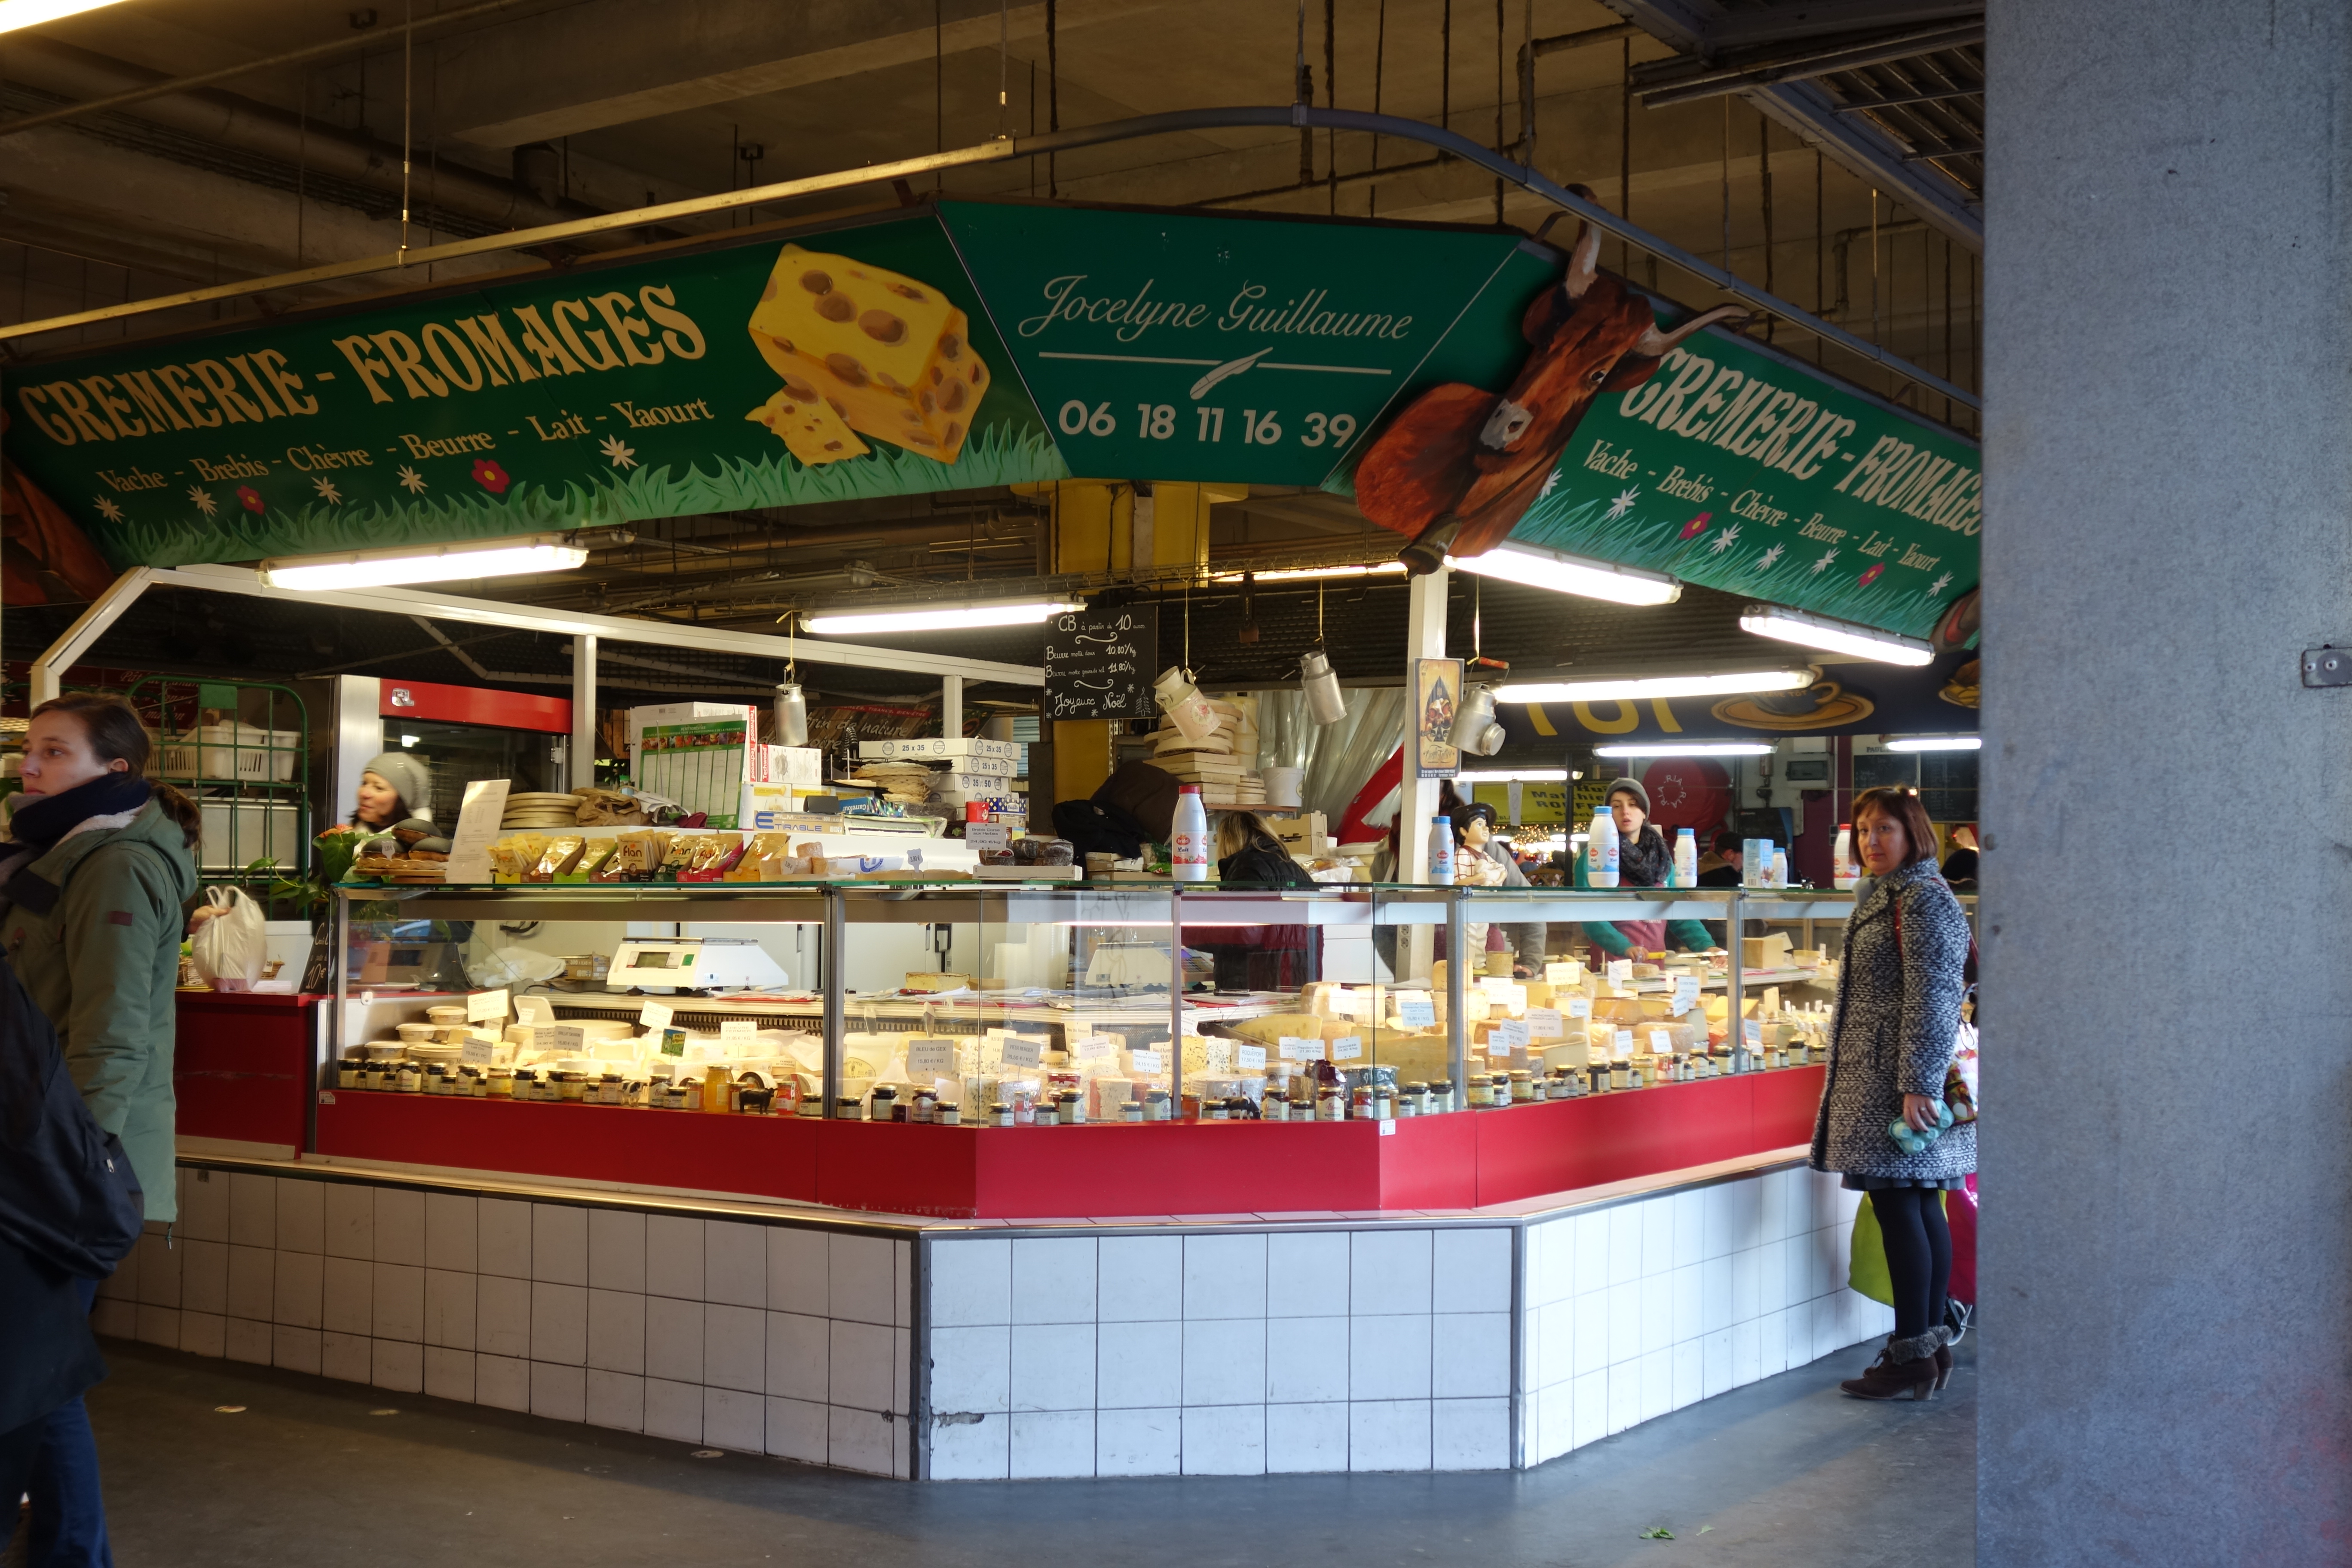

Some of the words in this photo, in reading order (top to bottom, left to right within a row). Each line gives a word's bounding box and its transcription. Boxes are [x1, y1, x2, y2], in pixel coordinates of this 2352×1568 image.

[1018, 275, 1212, 342] Jocelyne
[1218, 279, 1413, 340] Guillaume
[17, 348, 319, 447] CREMERIE
[332, 285, 707, 405] FROMAGES
[1058, 399, 1116, 436] 06
[1137, 404, 1176, 440] 18
[1197, 407, 1224, 442] 11
[1243, 410, 1282, 444] 16
[1301, 413, 1357, 448] 39
[1619, 346, 1857, 480] CREMERIE
[97, 464, 165, 494] Vache
[190, 453, 269, 484] Brebis
[287, 444, 374, 473] Chèvre
[399, 426, 497, 460] Beurre
[526, 410, 591, 442] Lait
[609, 396, 716, 430] Yaourt
[1582, 439, 1637, 480] Vache
[1655, 465, 1715, 504] Brebis
[1729, 489, 1787, 528] Chèvre
[1799, 512, 1847, 545] Beurre
[1858, 530, 1894, 558] Lait
[1897, 545, 1941, 573] Yaourt
[1058, 615, 1076, 631] CB
[1081, 622, 1086, 631] à
[1089, 623, 1104, 633] partir
[1116, 614, 1132, 631] 10
[1046, 646, 1069, 660] Beurre
[120, 671, 143, 682] Pât
[1046, 665, 1066, 678] Beurre
[1054, 692, 1096, 716] Joyeux
[1102, 692, 1127, 710] Noël
[861, 718, 909, 736] nature
[842, 804, 866, 813] Carrefour
[623, 845, 642, 857] flan
